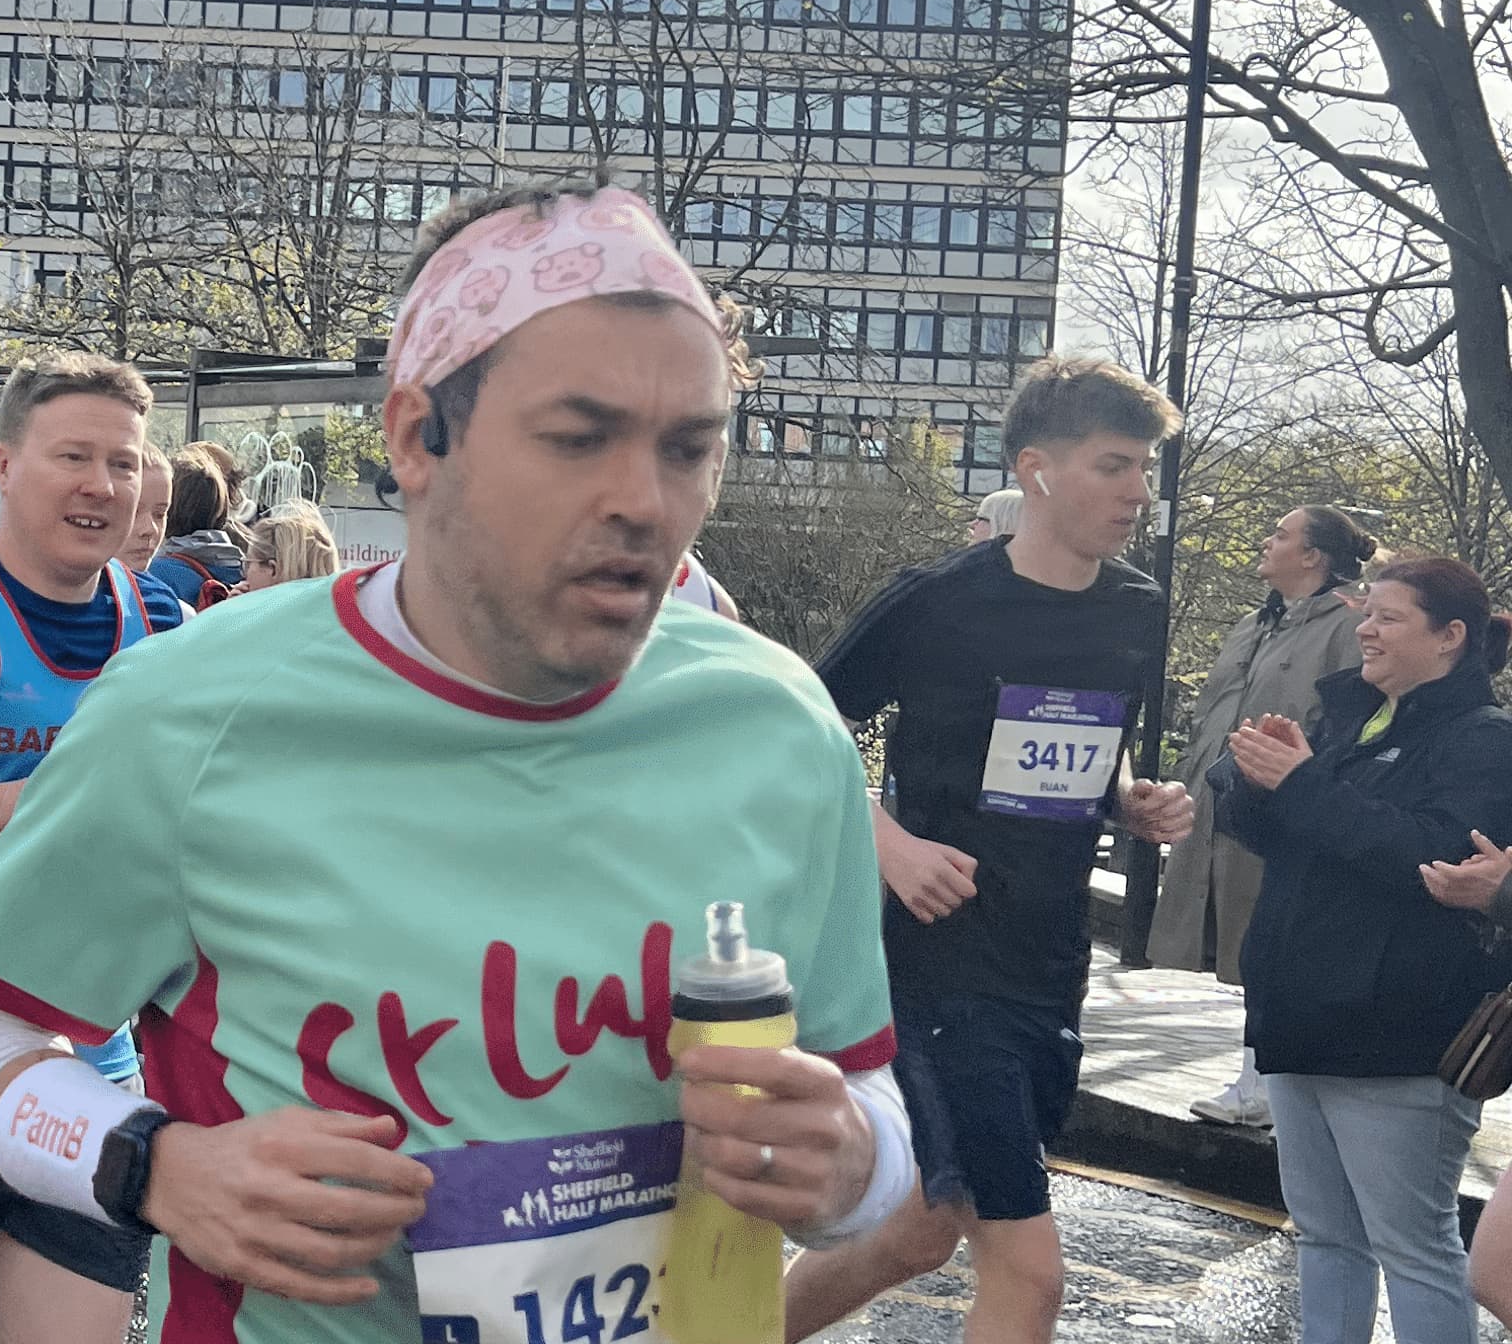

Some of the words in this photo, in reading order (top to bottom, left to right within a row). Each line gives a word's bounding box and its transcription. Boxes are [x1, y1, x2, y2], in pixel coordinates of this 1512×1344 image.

[1018, 739, 1101, 773] 3417
[1039, 782, 1069, 793] EUAN
[552, 1173, 634, 1202] SHEFFIELD
[553, 1199, 597, 1222] HALF
[445, 1322, 457, 1343] L
